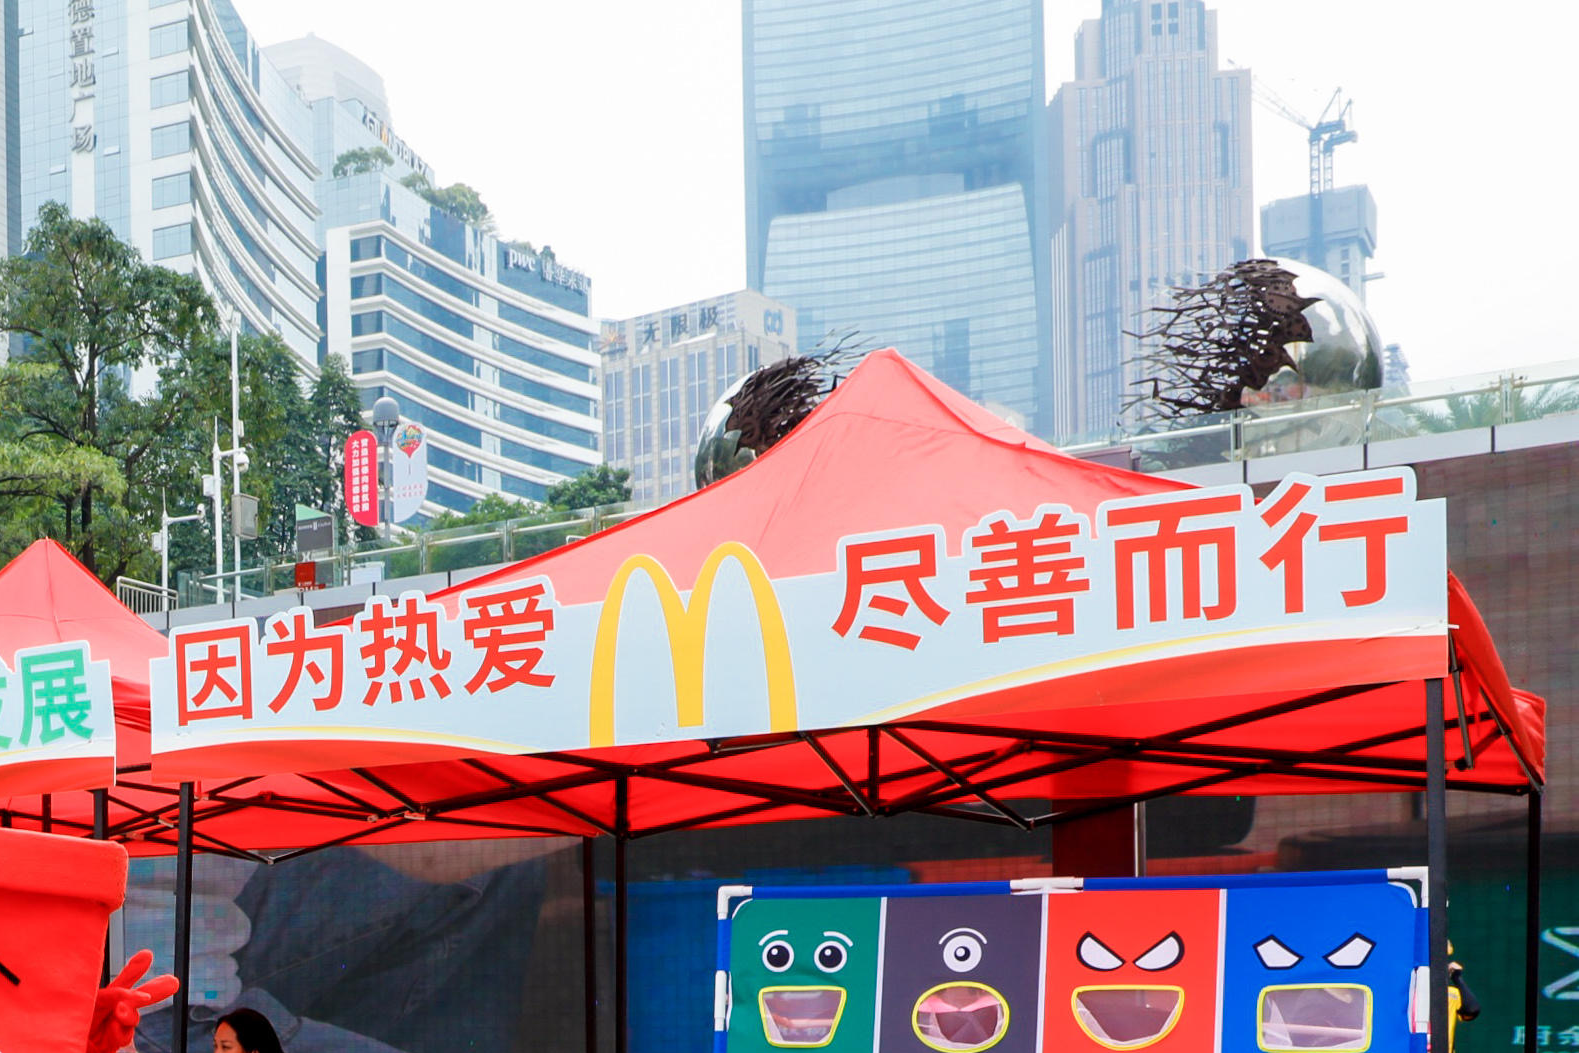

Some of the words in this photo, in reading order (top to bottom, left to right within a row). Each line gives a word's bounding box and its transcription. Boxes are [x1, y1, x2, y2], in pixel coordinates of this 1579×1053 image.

[643, 306, 719, 344] 无限极
[832, 477, 1408, 653] 尽善而行
[175, 584, 556, 727] 因为热爱
